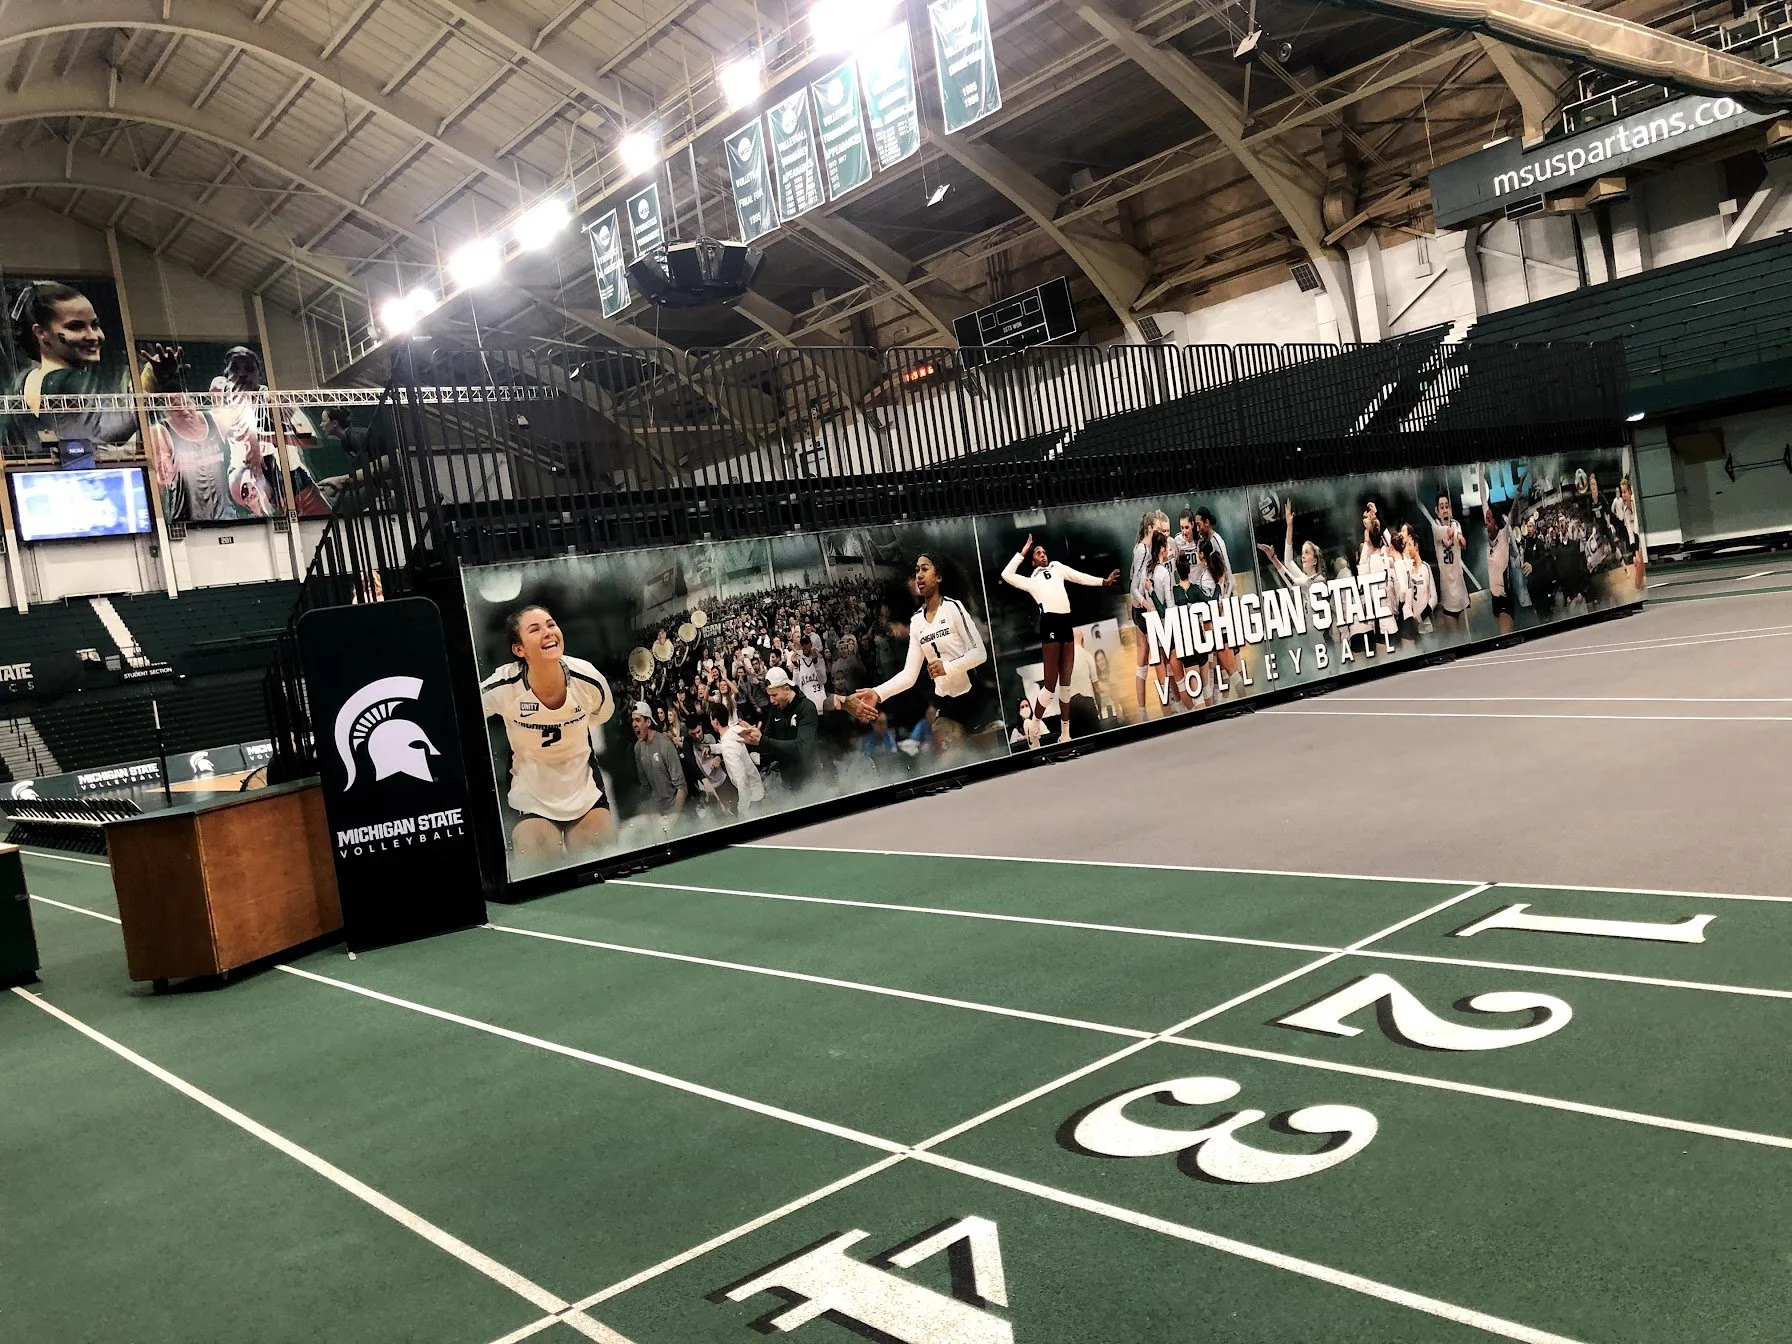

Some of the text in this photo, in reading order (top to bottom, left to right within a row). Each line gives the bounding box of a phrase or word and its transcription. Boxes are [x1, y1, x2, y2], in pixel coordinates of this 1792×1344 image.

[1042, 570, 1052, 580] 6
[1142, 572, 1393, 666] MICHIGAN STATE
[123, 666, 173, 680] STUDENT SECTION
[1154, 630, 1396, 705] VOLLEYBALL
[521, 703, 538, 711] UNITY
[246, 743, 273, 757] MICHI
[541, 728, 562, 748] 2
[77, 762, 160, 786] MICHIGAN STATE
[80, 772, 161, 791] VOLLEYBALL
[336, 808, 465, 848] MICHIGAN STATE
[340, 826, 465, 859] VOLLEYBALL
[1455, 902, 1719, 945] 1
[1275, 971, 1574, 1052] 2
[1072, 1075, 1380, 1184] 3
[722, 1214, 1016, 1344] 4
